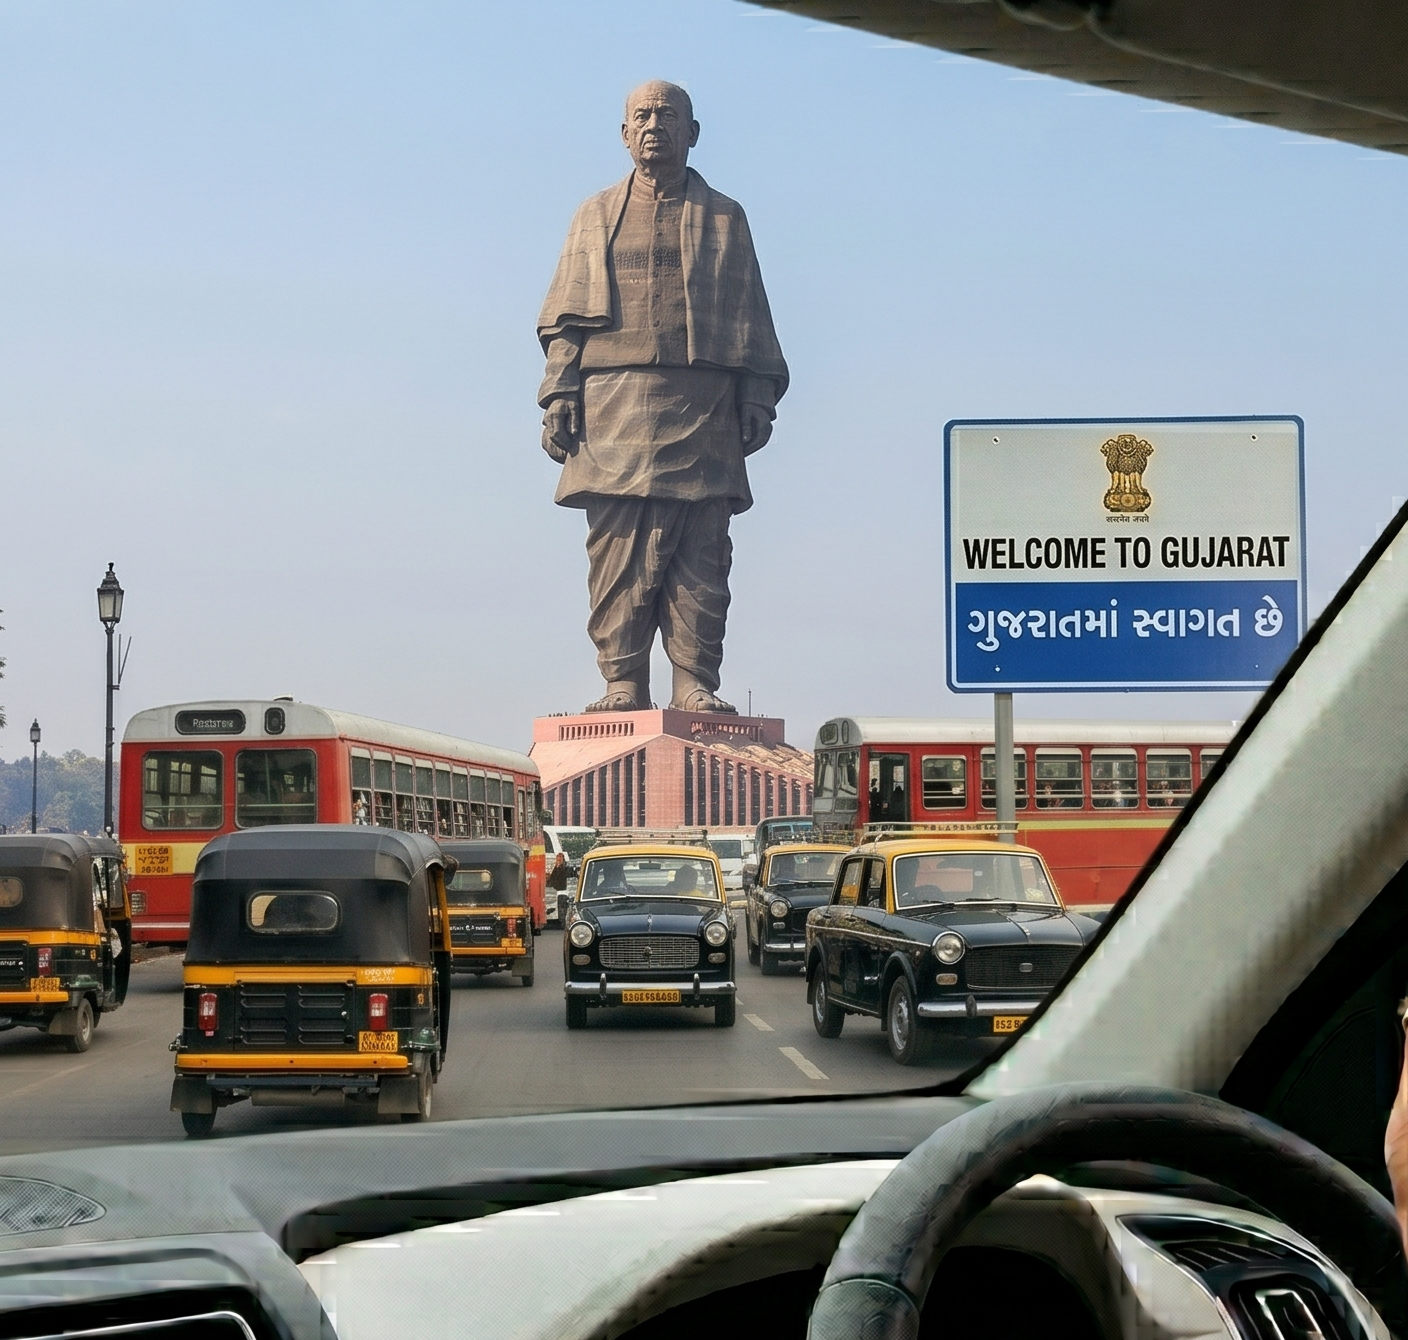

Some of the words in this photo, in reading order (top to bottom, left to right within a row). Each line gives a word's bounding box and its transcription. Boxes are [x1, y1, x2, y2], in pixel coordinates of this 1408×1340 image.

[962, 537, 1106, 570] WELCOME
[1114, 536, 1152, 569] TO
[1160, 535, 1291, 569] GUJARAT
[967, 598, 1119, 652] ગુજરાતમાં
[1132, 607, 1241, 638] સ્વાગત
[1254, 594, 1285, 638] છે
